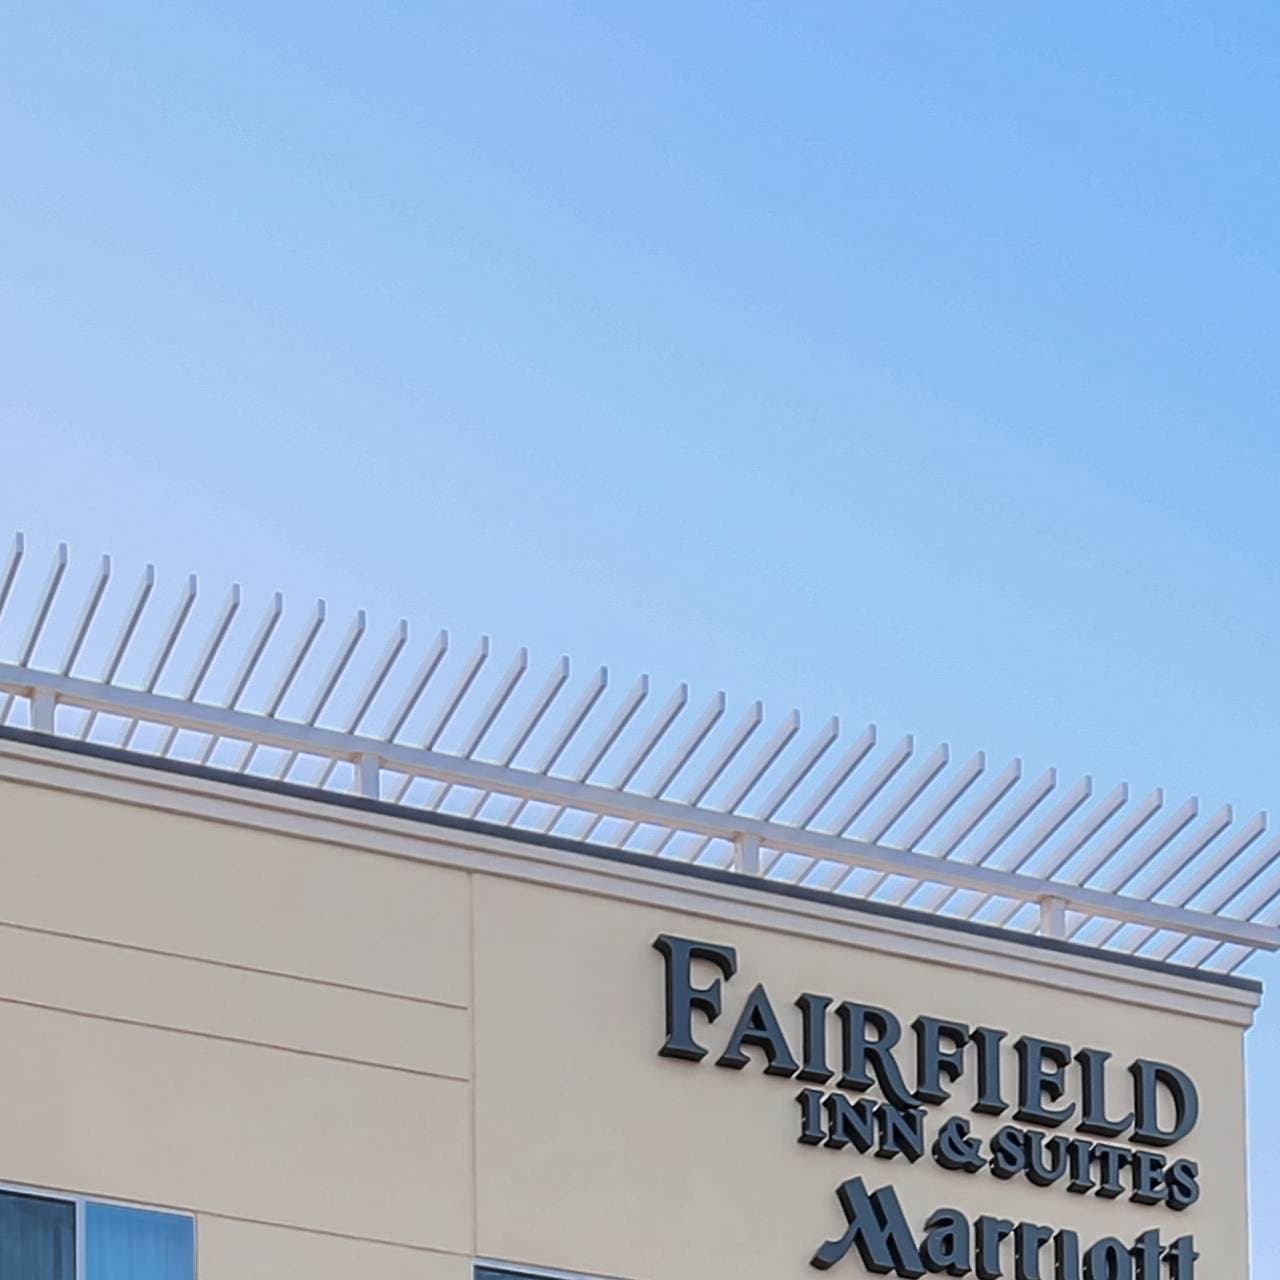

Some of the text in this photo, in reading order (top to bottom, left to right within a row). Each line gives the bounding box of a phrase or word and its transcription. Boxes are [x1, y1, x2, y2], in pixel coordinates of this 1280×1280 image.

[652, 933, 1199, 1147] FAIRFIELD
[795, 1088, 1200, 1212] INN & SUITES
